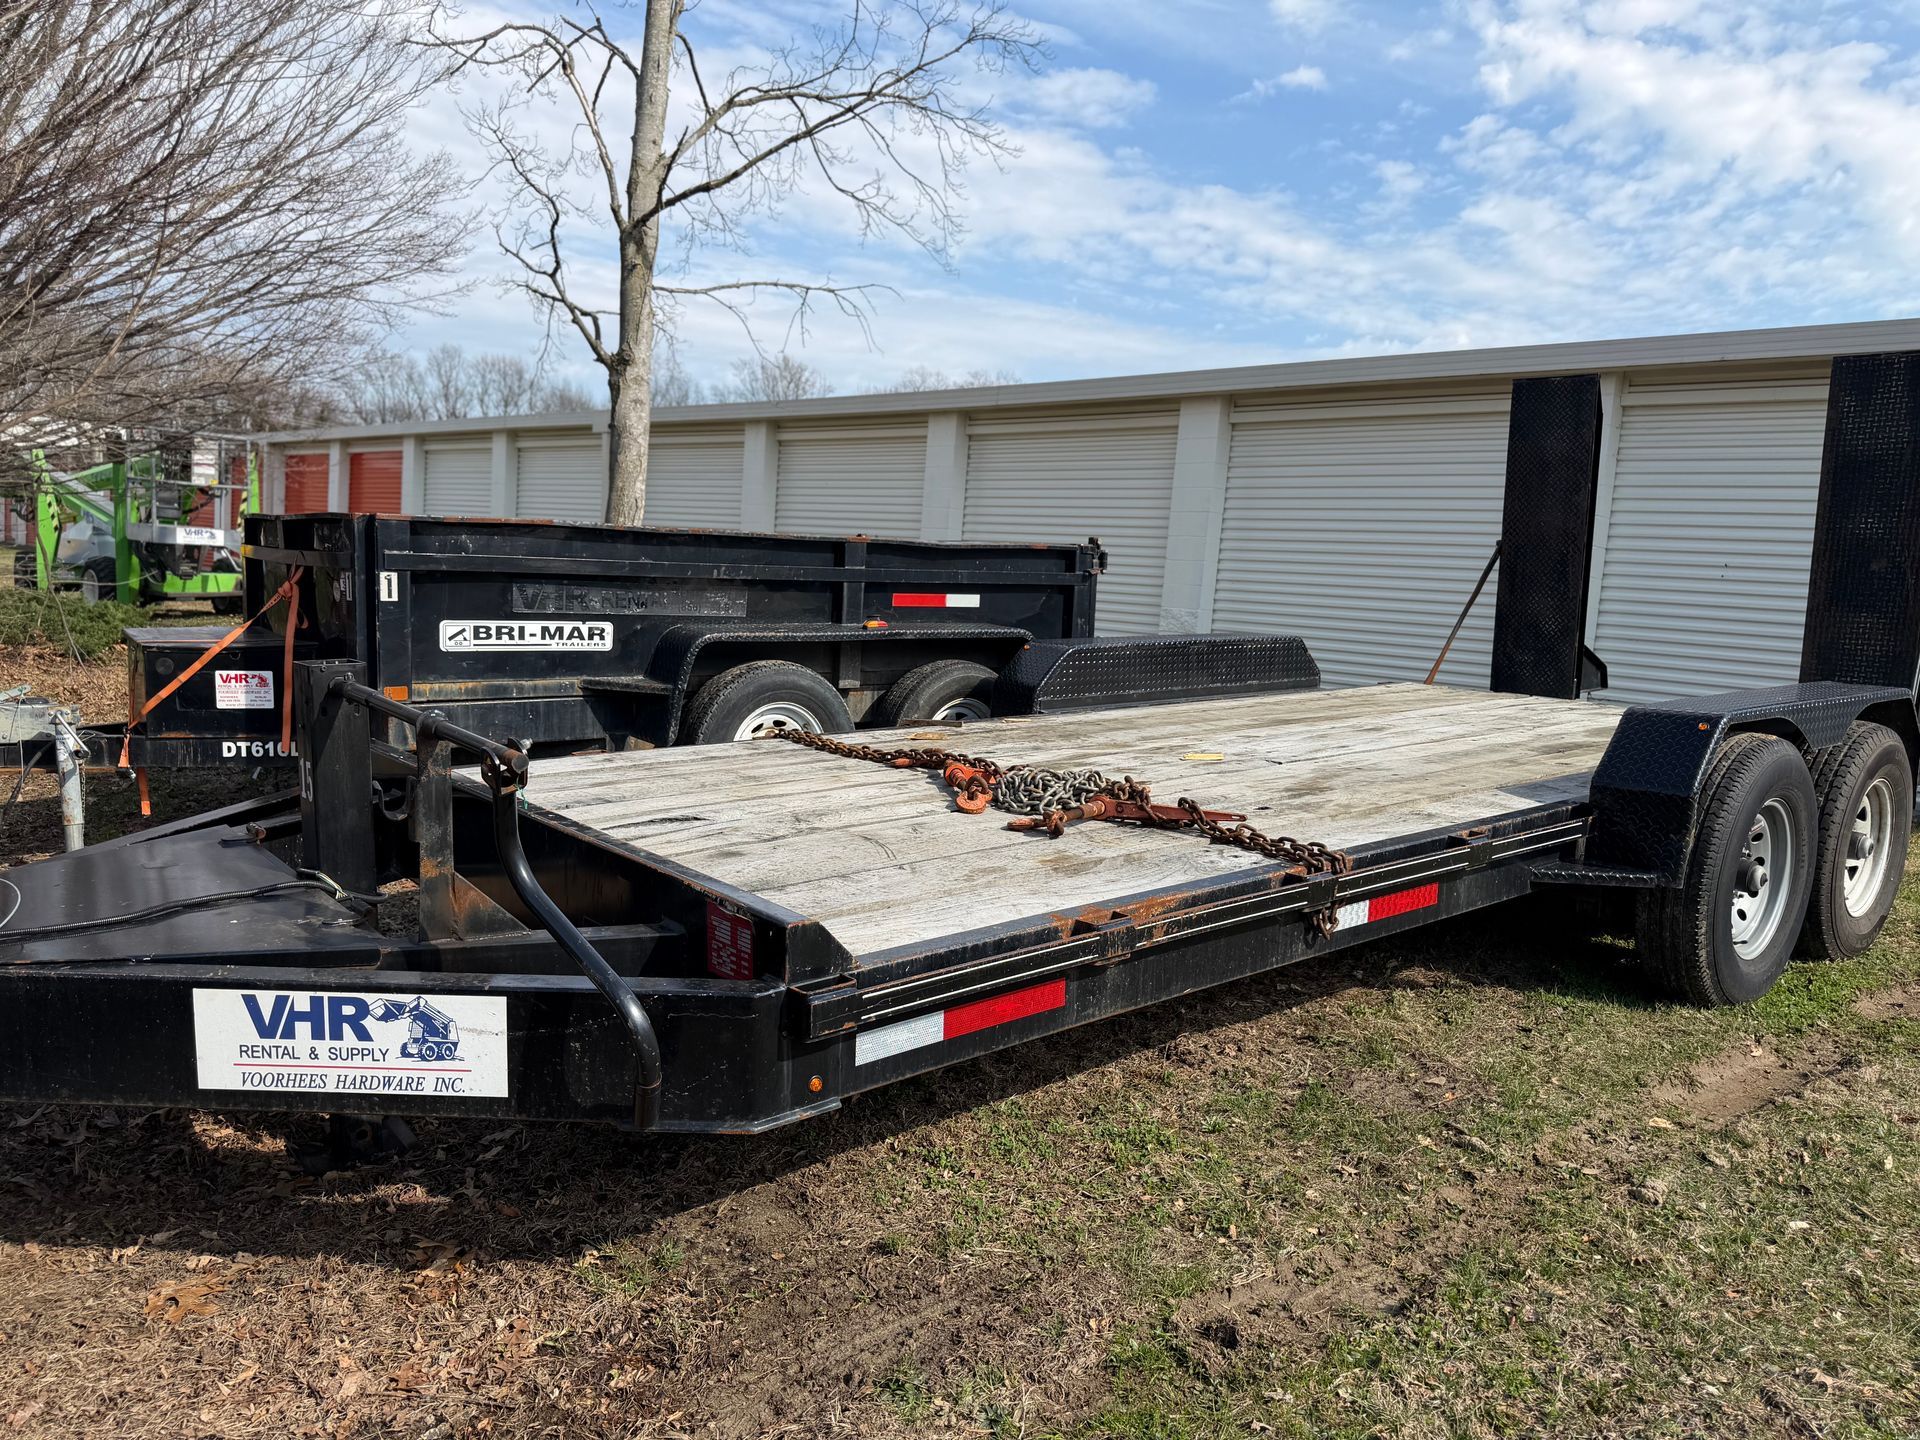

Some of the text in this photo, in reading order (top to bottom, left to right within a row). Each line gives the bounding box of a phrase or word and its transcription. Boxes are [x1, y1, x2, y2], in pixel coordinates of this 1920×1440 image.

[384, 574, 393, 599] 1
[601, 590, 670, 609] RENTA
[472, 625, 606, 641] BRI-MAR
[219, 673, 250, 684] VHR
[300, 758, 313, 802] 15
[240, 993, 375, 1043] VHR
[239, 1044, 390, 1063] RENTAL & SUPPLY
[240, 1071, 466, 1094] VOORHEES HARDWARE INC.
